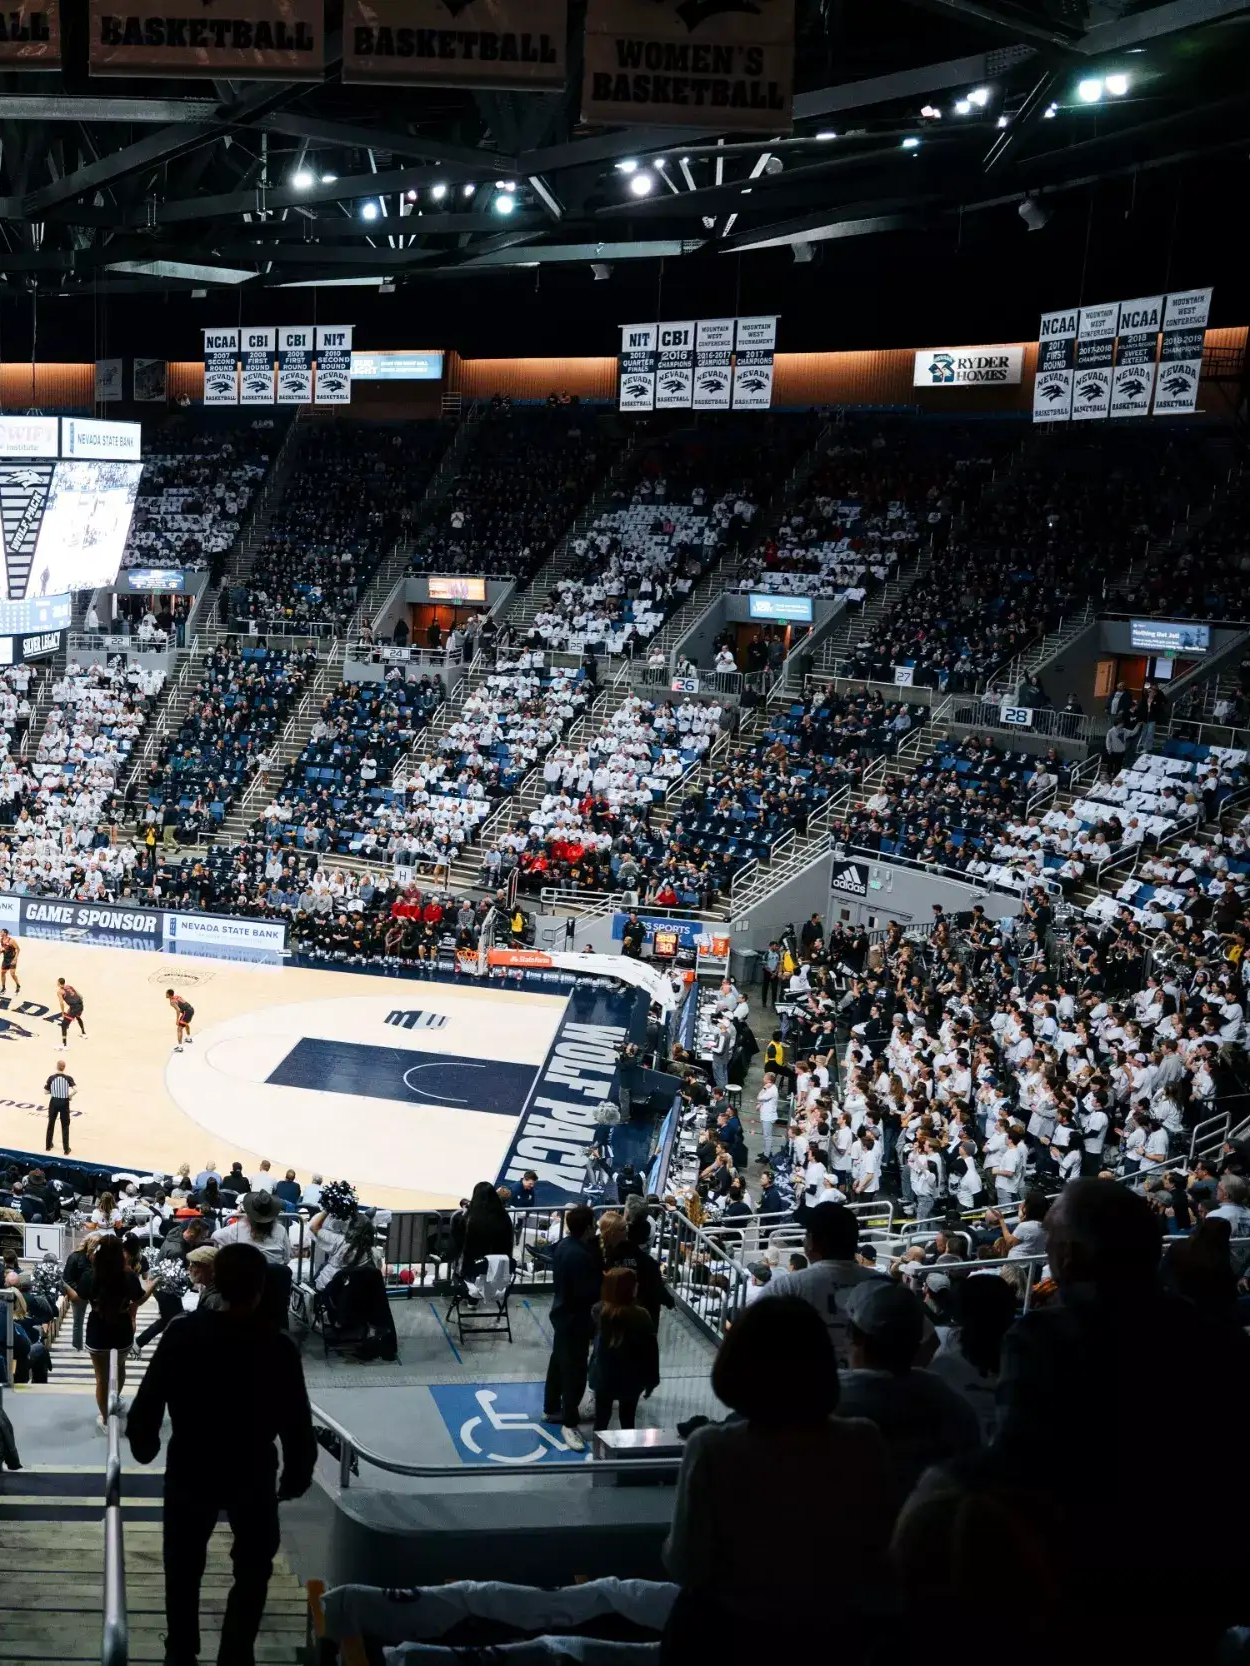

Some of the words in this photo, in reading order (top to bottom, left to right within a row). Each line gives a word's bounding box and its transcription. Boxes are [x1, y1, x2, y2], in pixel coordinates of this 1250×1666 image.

[101, 16, 314, 51] BASKETBALL
[354, 27, 556, 63] BASKETBALL
[617, 40, 763, 75] WOMEN'S
[594, 73, 785, 110] BASKETBALL
[1172, 295, 1205, 306] MOUNTAIN
[1178, 307, 1196, 315] WEST
[1121, 309, 1158, 330] NCAA
[1166, 316, 1206, 327] CONFERENCE
[1041, 316, 1075, 336] NCAA
[207, 336, 236, 348] NCAA
[249, 335, 268, 347] CBI
[287, 334, 306, 347] CBI
[324, 334, 345, 346] NIT
[630, 333, 650, 347] NIT
[662, 330, 689, 346] CBI
[1127, 333, 1147, 343] 2018
[1049, 341, 1066, 350] 2017
[1079, 344, 1112, 355] 2017-2018
[662, 351, 687, 360] 2016
[1046, 351, 1066, 361] FIRST
[1078, 354, 1111, 363] CHAMPIONS
[1124, 348, 1148, 357] SWEET
[623, 359, 654, 367] QUARTER
[958, 356, 1009, 369] RYDER
[1043, 360, 1066, 370] ROUND
[1121, 356, 1149, 365] SIXTEEN
[206, 374, 236, 383] NEVADA
[243, 373, 272, 383] NEVADA
[280, 372, 309, 382] NEVADA
[318, 372, 348, 382] NEVADA
[659, 371, 689, 382] NEVADA
[697, 370, 728, 382] NEVADA
[737, 370, 769, 382] NEVADA
[957, 369, 1007, 381] HOMES
[1115, 366, 1150, 384] NEVADA
[1160, 364, 1196, 381] NEVADA
[623, 376, 652, 387] NEVADA
[1037, 372, 1069, 389] NEVADA
[1076, 371, 1109, 389] NEVADA
[1112, 401, 1147, 410] BASKETBALL
[1156, 399, 1193, 408] BASKETBALL
[78, 433, 101, 445] NEVADA
[102, 435, 118, 447] STATE
[119, 436, 134, 448] BANK
[10, 519, 29, 551] WOLF
[25, 492, 43, 522] PACK
[22, 636, 41, 655] SILVER
[41, 631, 61, 650] LEGACY
[111, 637, 124, 645] 22
[570, 642, 583, 650] 25
[389, 649, 402, 657] 24
[896, 672, 910, 682] 27
[677, 679, 695, 691] 26
[1005, 710, 1028, 723] 28
[833, 877, 867, 895] adidas
[26, 904, 74, 923] GAME
[77, 909, 157, 933] SPONSOR
[182, 922, 219, 932] NEVADA
[222, 926, 249, 935] STATE
[252, 929, 279, 938] BANK
[652, 923, 691, 935] SPORTS
[660, 943, 673, 953] 30
[544, 1022, 627, 1099] WOLF
[505, 1096, 599, 1194] PACK
[37, 1235, 48, 1251] L
